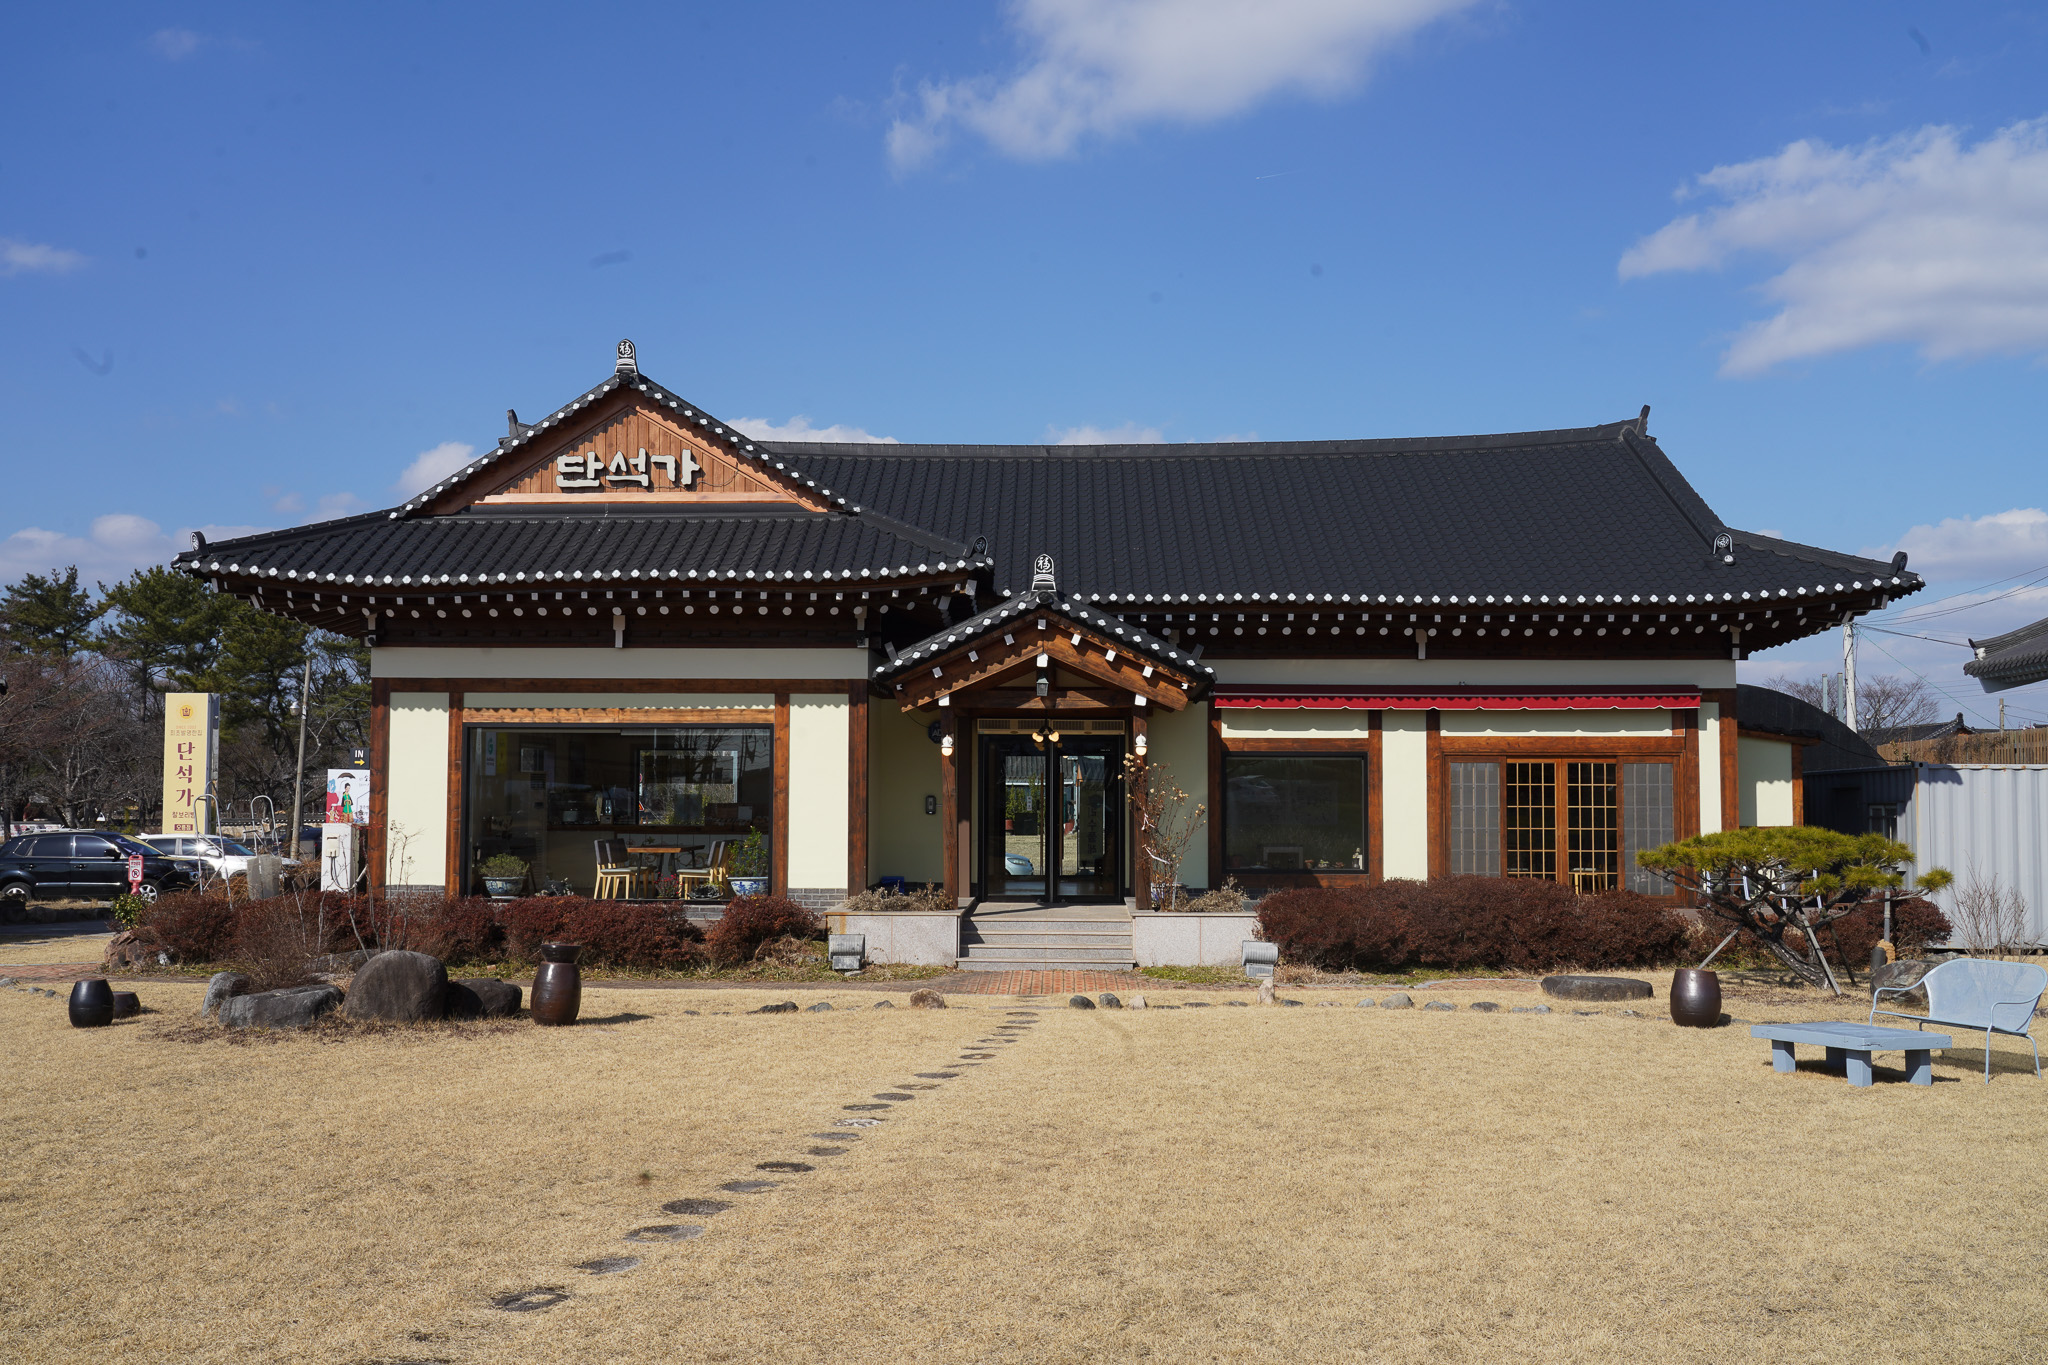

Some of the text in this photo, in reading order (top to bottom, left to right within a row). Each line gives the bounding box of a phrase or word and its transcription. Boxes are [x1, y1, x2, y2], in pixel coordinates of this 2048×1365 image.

[555, 447, 701, 488] 단석가
[354, 749, 364, 758] IN
[176, 741, 196, 808] 단석가
